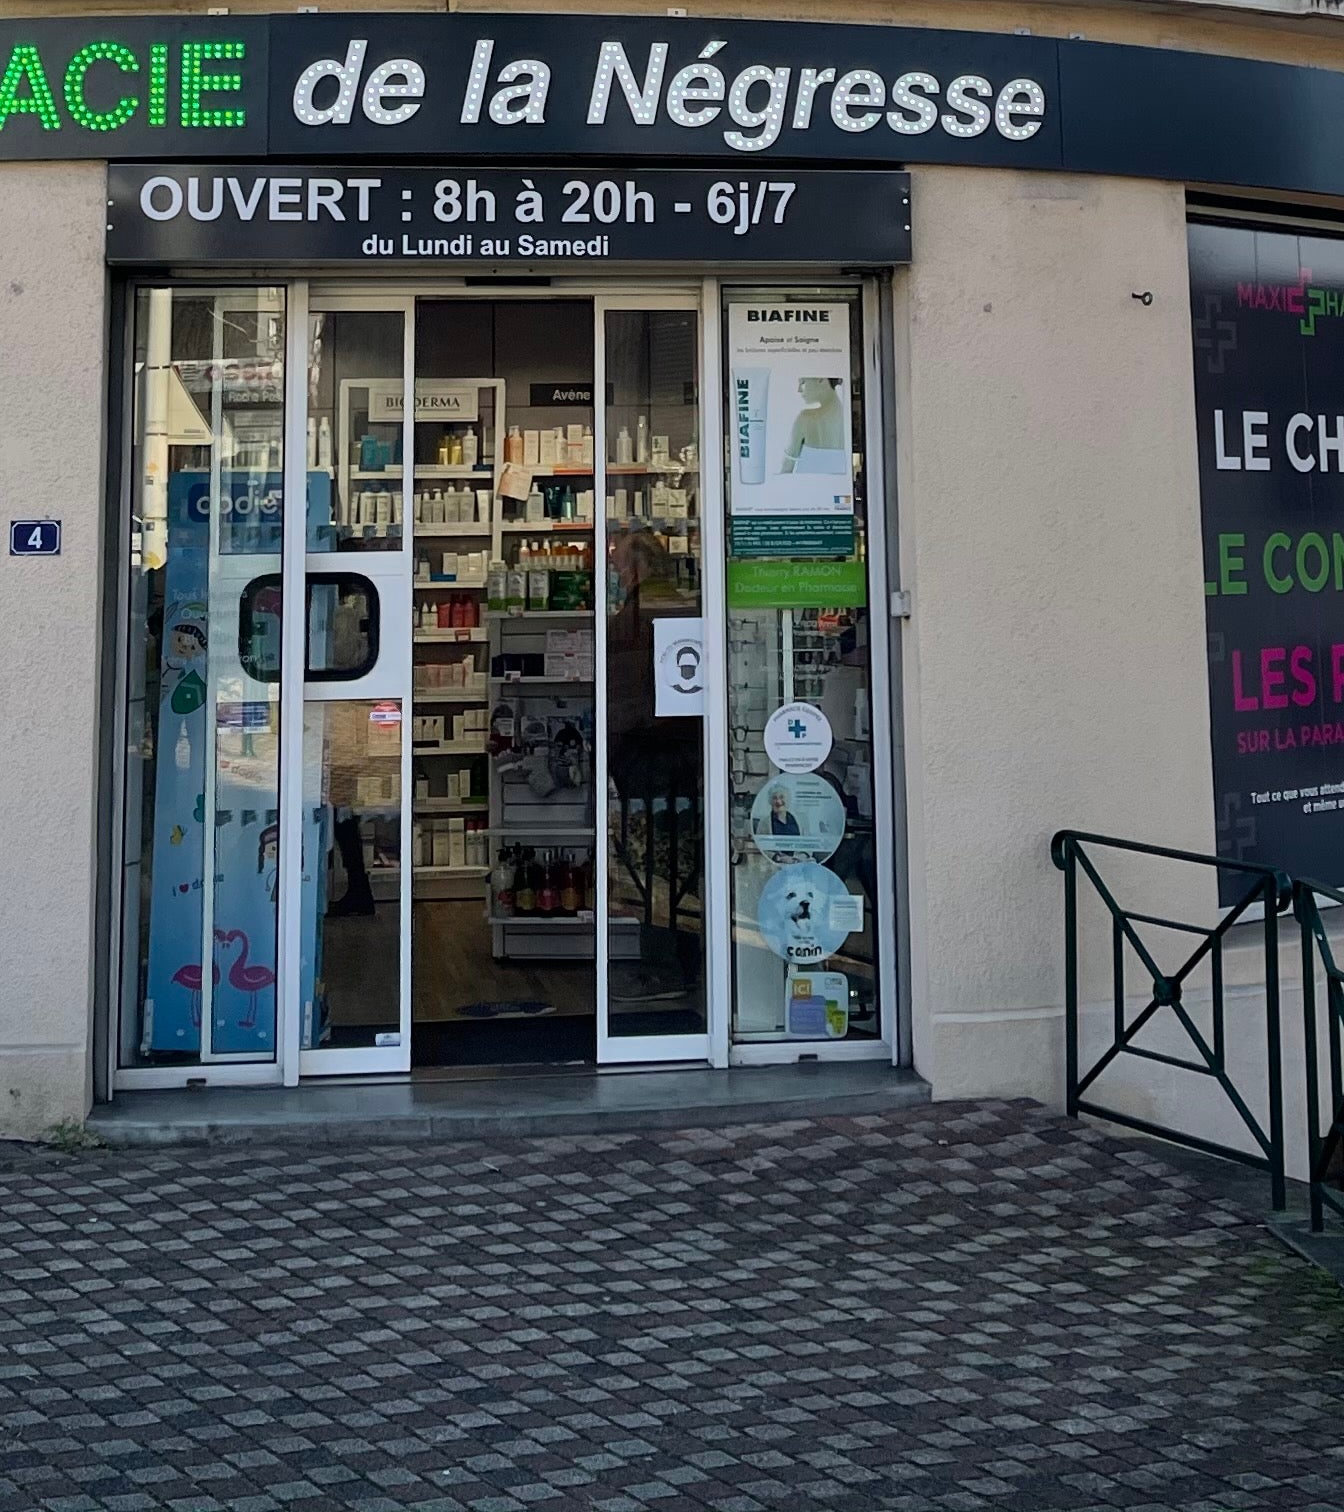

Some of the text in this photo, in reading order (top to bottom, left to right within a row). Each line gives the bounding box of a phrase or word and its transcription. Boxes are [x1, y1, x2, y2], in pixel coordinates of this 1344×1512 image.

[291, 39, 426, 125] de
[460, 39, 552, 125] la
[586, 41, 1046, 152] Négresse
[139, 176, 382, 221] OUVERT
[433, 180, 497, 223] 8h
[514, 178, 546, 223] à
[561, 180, 655, 223] 20h
[706, 180, 796, 234] 6j/7
[362, 234, 610, 257] du Lundi au Samedi
[747, 309, 830, 323] BIAFINE
[760, 336, 785, 344] Apaise
[795, 336, 820, 344] Soigne
[552, 389, 591, 401] Avène
[737, 378, 750, 458] BIAFINE
[1214, 409, 1272, 472] LE
[27, 526, 43, 549] 4
[735, 582, 779, 593] Docteur
[781, 584, 796, 593] en
[1232, 645, 1317, 712] LES
[1237, 729, 1270, 754] SUR
[1275, 727, 1297, 750] LA
[1251, 791, 1271, 804] Tout
[1271, 791, 1282, 801] ce
[1283, 789, 1298, 802] que
[1299, 786, 1319, 798] vous
[1303, 801, 1312, 814] et
[1313, 799, 1337, 812] même
[787, 944, 823, 958] canin
[794, 985, 810, 995] ICI
